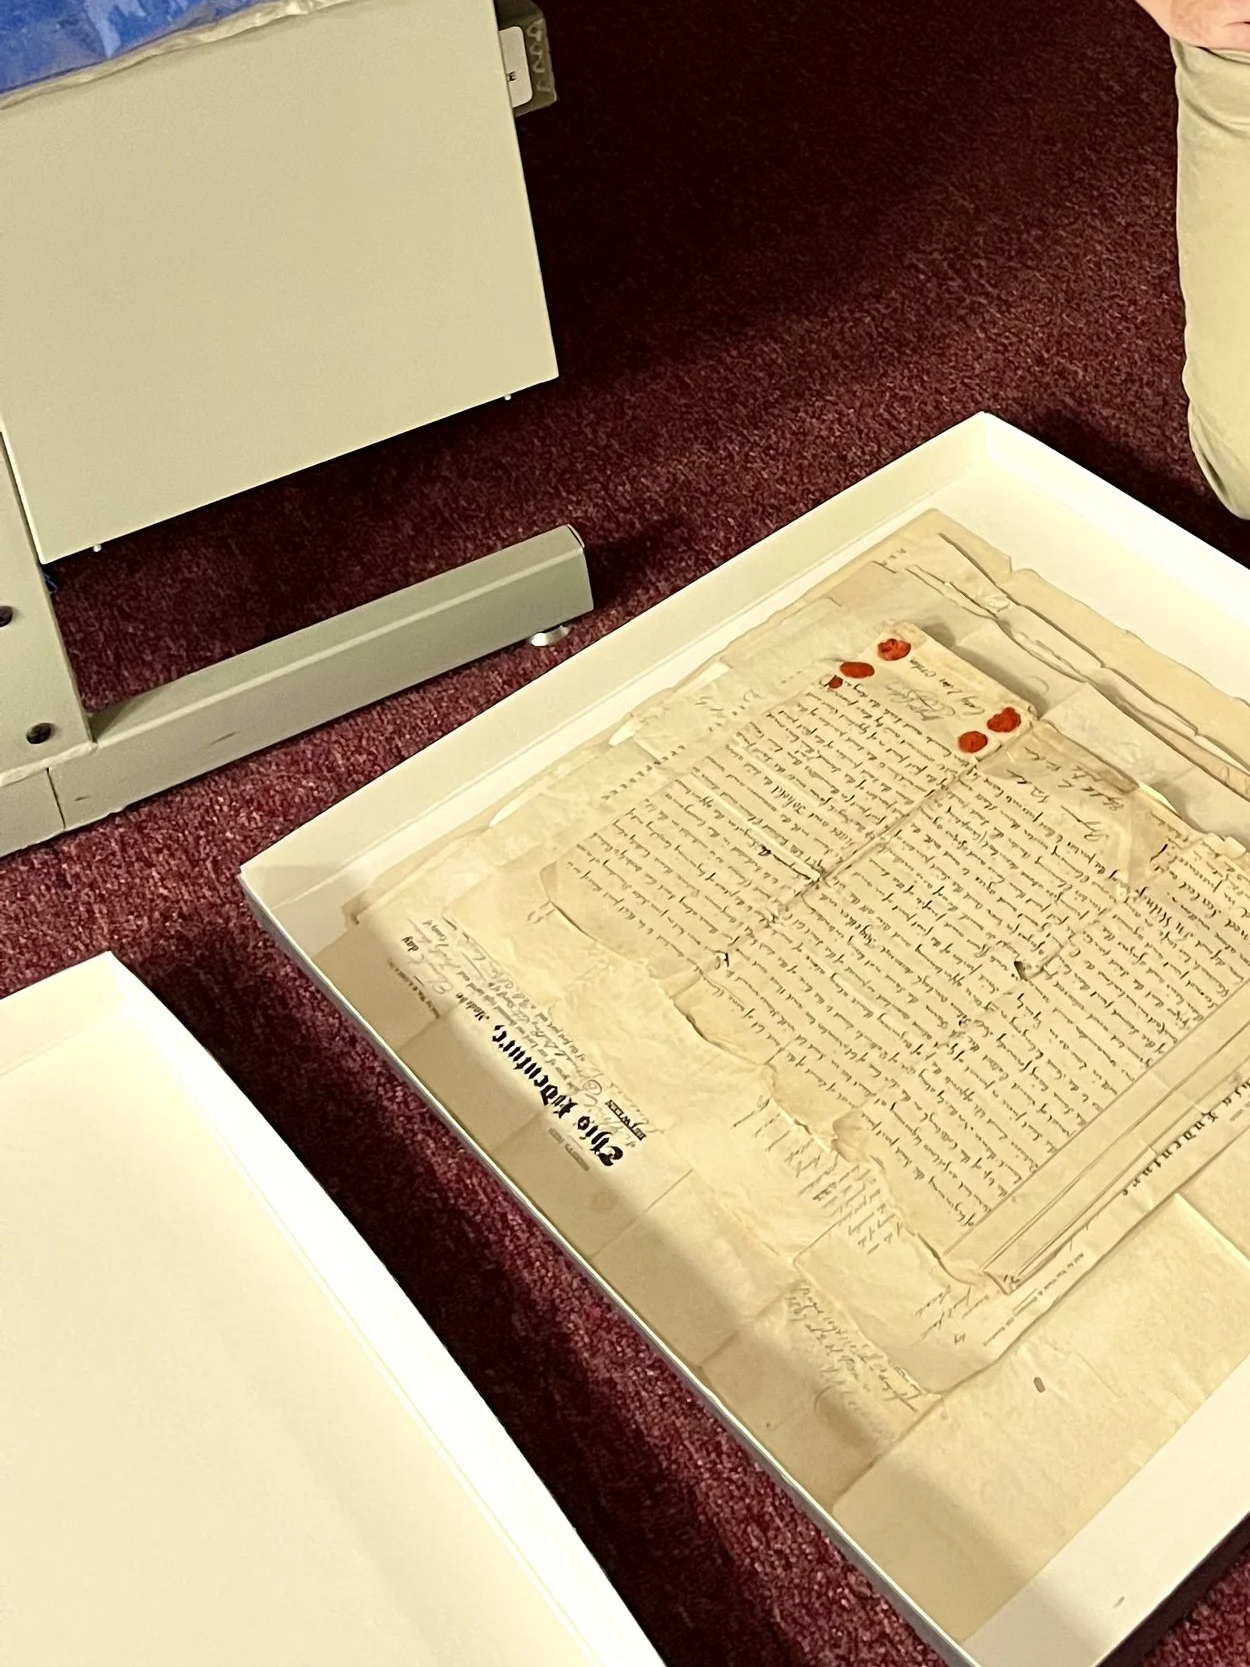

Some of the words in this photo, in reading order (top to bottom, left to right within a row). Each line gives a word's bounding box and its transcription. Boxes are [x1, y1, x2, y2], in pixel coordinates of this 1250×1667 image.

[401, 935, 419, 952] day
[491, 1024, 578, 1119] Indenture,
[572, 1114, 623, 1167] This
[604, 1098, 647, 1141] BETWEEN
[624, 1140, 636, 1148] of
